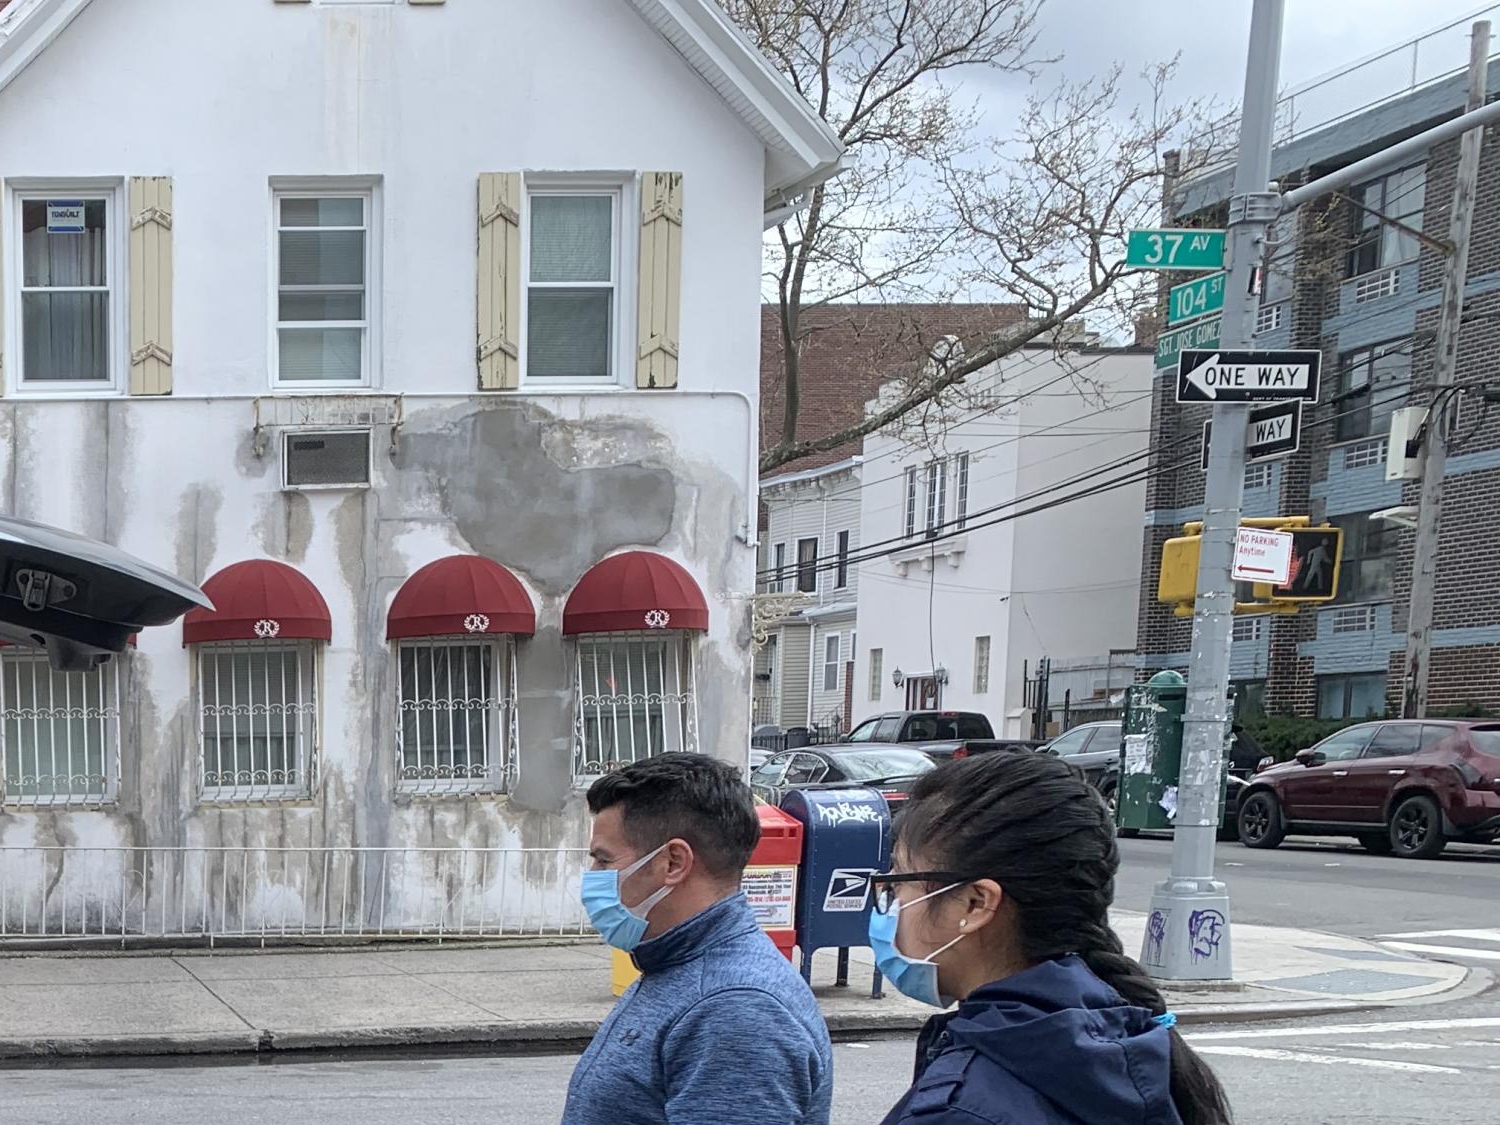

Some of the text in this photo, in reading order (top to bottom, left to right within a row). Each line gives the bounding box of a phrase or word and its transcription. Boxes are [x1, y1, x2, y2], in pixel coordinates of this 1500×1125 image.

[1144, 234, 1211, 264] 37 AV
[1176, 276, 1224, 318] 104 ST
[1205, 367, 1300, 386] ONE WAY
[1256, 418, 1286, 443] WAY
[1239, 546, 1266, 557] Anytime
[1240, 534, 1279, 547] NO PARKING
